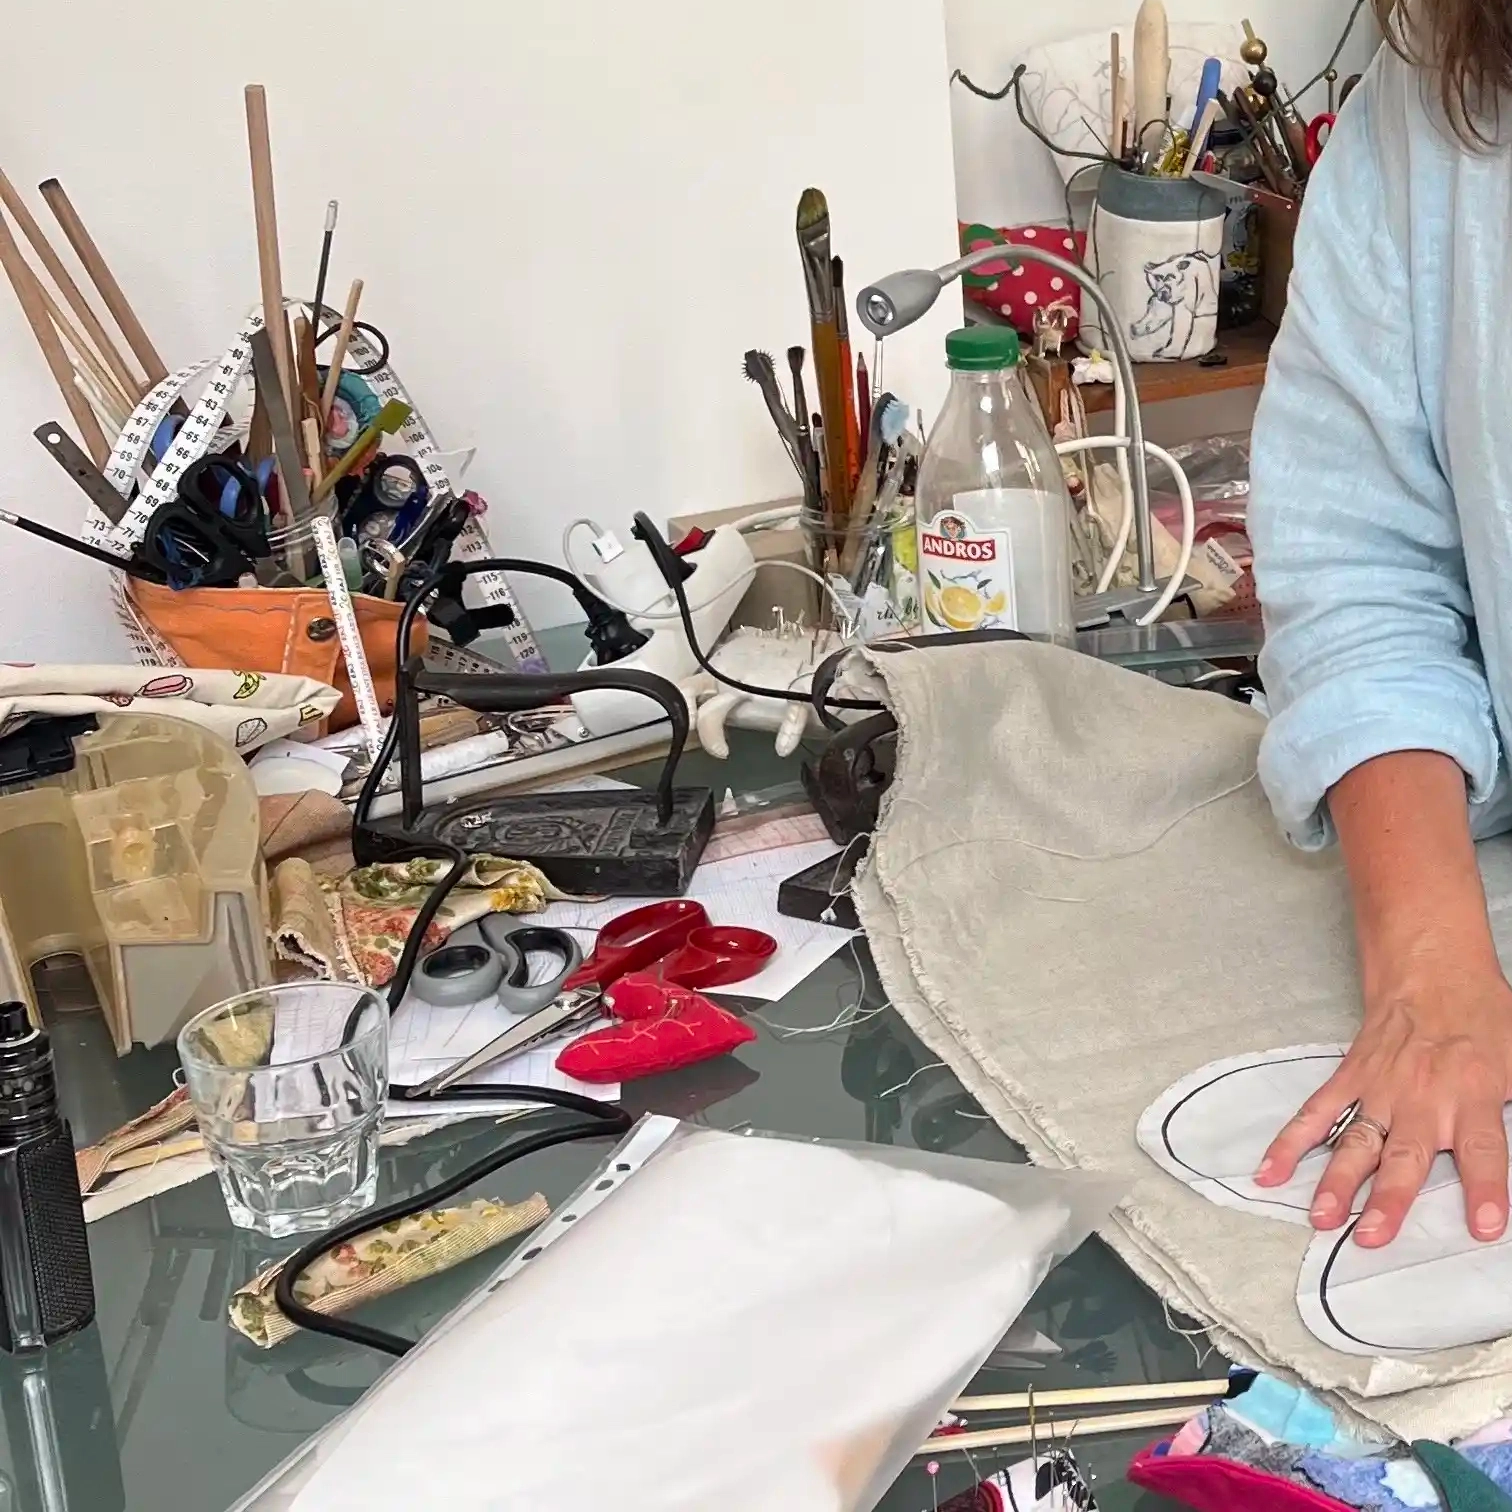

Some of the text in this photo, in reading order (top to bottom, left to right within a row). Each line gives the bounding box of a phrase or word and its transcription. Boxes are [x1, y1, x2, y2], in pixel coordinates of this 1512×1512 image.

[374, 373, 390, 383] 102
[156, 390, 169, 400] 65
[383, 387, 399, 397] 103
[135, 417, 149, 427] 67
[196, 415, 209, 427] 64
[127, 433, 141, 445] 68
[186, 431, 199, 443] 65
[409, 432, 425, 443] 106
[120, 450, 133, 462] 69
[176, 447, 190, 459] 66
[166, 460, 180, 474] 67
[112, 467, 126, 480] 70
[156, 478, 169, 491] 68
[145, 495, 159, 508] 69
[135, 510, 149, 524] 70
[93, 518, 106, 531] 73
[123, 527, 135, 538] 71
[111, 539, 125, 552] 72
[466, 541, 482, 554] 113
[923, 536, 994, 561] ANDROS
[482, 573, 499, 585] 115
[489, 588, 506, 601] 116
[513, 632, 528, 645] 119
[520, 647, 535, 659] 120
